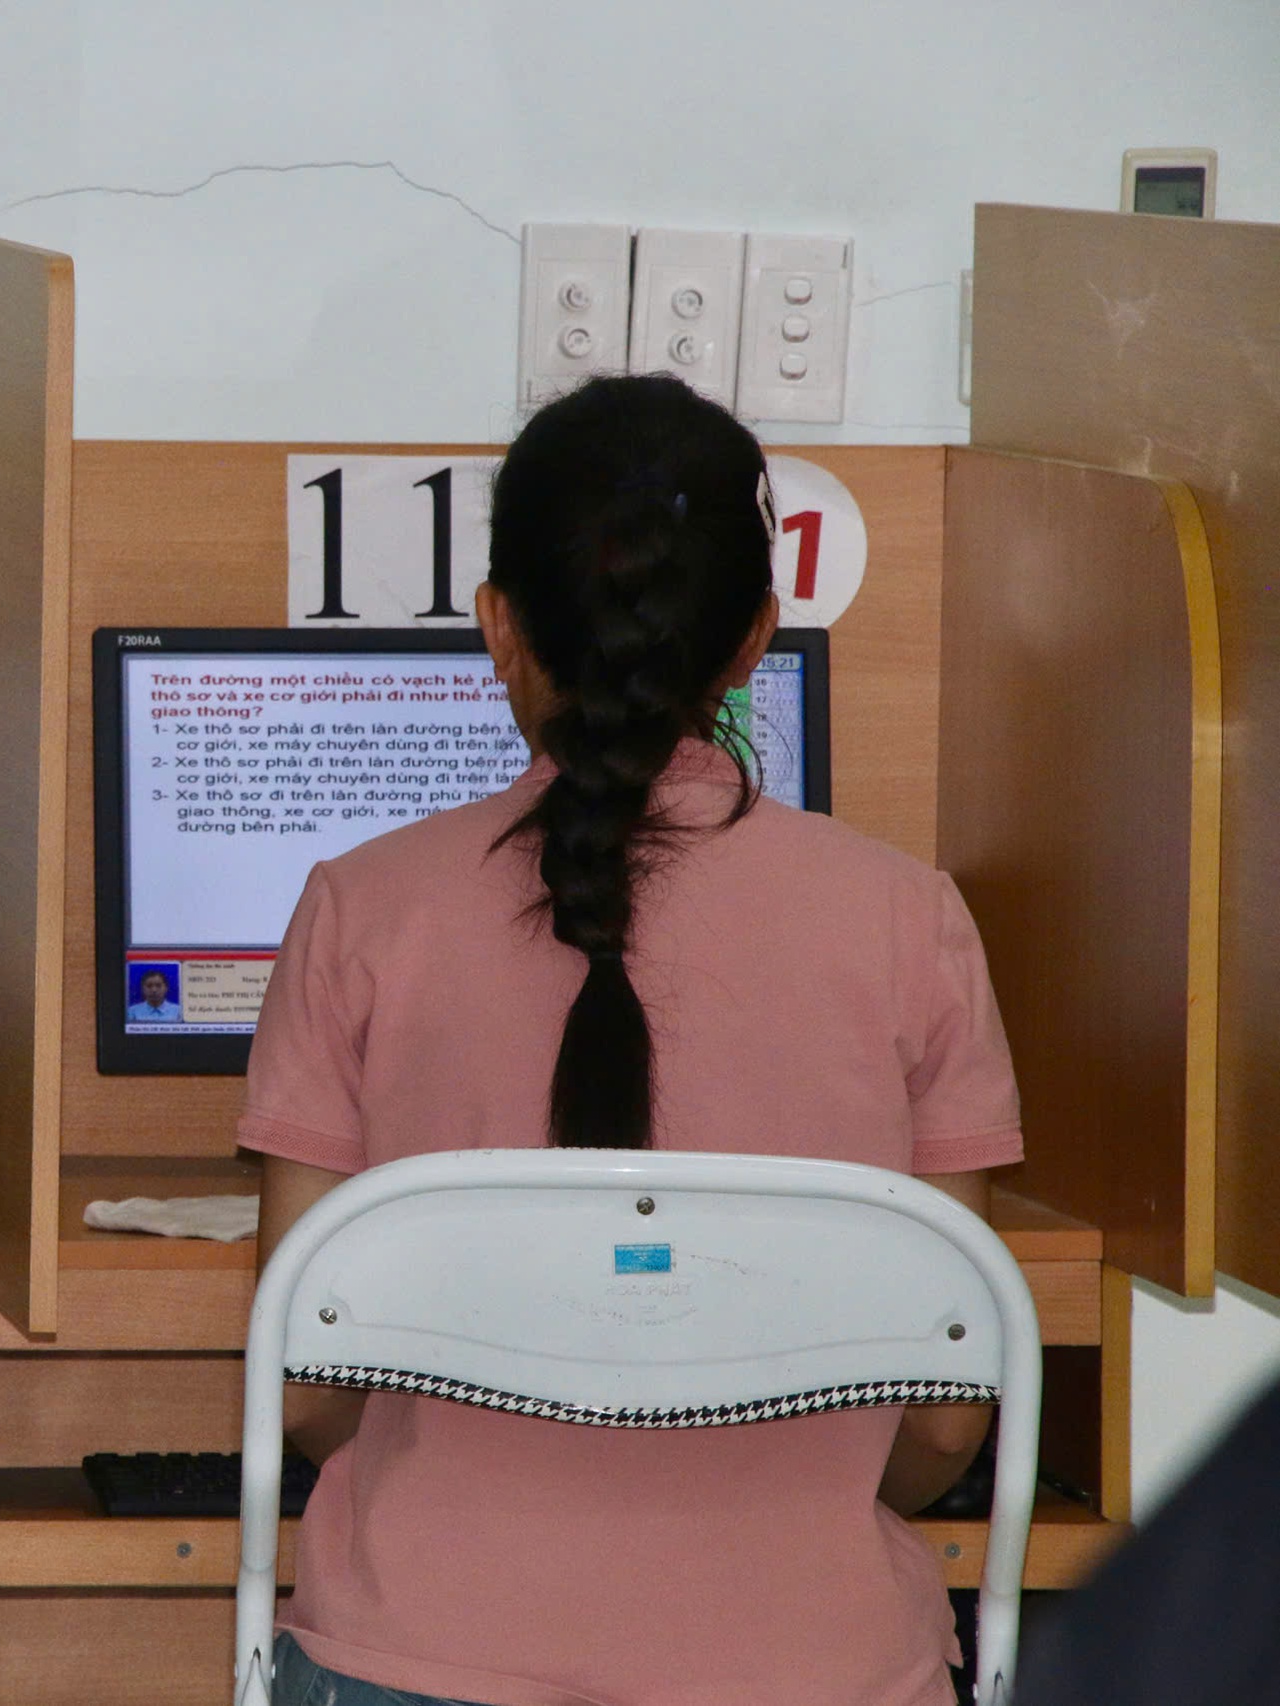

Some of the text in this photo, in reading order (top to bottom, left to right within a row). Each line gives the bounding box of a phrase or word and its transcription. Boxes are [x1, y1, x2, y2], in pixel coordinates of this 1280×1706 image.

[303, 467, 469, 619] 11
[782, 510, 823, 600] 1
[118, 635, 161, 647] F20RAA
[151, 674, 192, 686] Trên
[200, 673, 263, 688] đường
[271, 675, 306, 688] một
[371, 674, 394, 686] có
[402, 674, 446, 688] vạch
[151, 690, 181, 701] thô
[187, 692, 212, 702] sơ
[216, 691, 238, 701] và
[243, 692, 265, 702] xe
[270, 692, 296, 702] cơ
[387, 691, 403, 701] đi
[410, 691, 448, 701] như
[151, 706, 263, 720] giao thông?
[152, 724, 168, 735] 1-
[175, 724, 199, 735] Xe
[204, 723, 232, 735] thô
[239, 725, 261, 735] sơ
[310, 724, 326, 735] đi
[332, 723, 365, 735] trên
[403, 723, 463, 737] đường
[469, 724, 501, 735] bên
[176, 741, 200, 751] cơ
[248, 741, 269, 751] xe
[274, 739, 311, 752] máy
[316, 739, 380, 752] chuyên
[434, 740, 449, 750] đi
[455, 740, 488, 750] trên
[151, 757, 168, 768] 2-
[175, 757, 199, 768] Xe
[204, 757, 232, 768] thô
[237, 759, 260, 768] sơ
[308, 757, 323, 768] đi
[329, 757, 362, 768] trên
[400, 757, 458, 770] đường
[465, 757, 498, 768] bên
[177, 774, 200, 784] cơ
[248, 774, 269, 784] xe
[275, 773, 312, 786] máy
[317, 773, 380, 786] chuyên
[435, 773, 450, 784] đi
[456, 773, 489, 784] trên
[151, 790, 169, 801] 3-
[175, 790, 199, 801] Xe
[206, 790, 234, 801] thô
[240, 792, 262, 801] sơ
[269, 790, 284, 801] đi
[291, 790, 325, 801] trên
[364, 789, 421, 803] đường
[177, 807, 215, 819] giao
[222, 806, 276, 819] thông,
[284, 808, 304, 817] xe
[311, 808, 334, 817] cơ
[387, 808, 407, 817] xe
[177, 821, 236, 835] đường
[241, 821, 275, 832] bên
